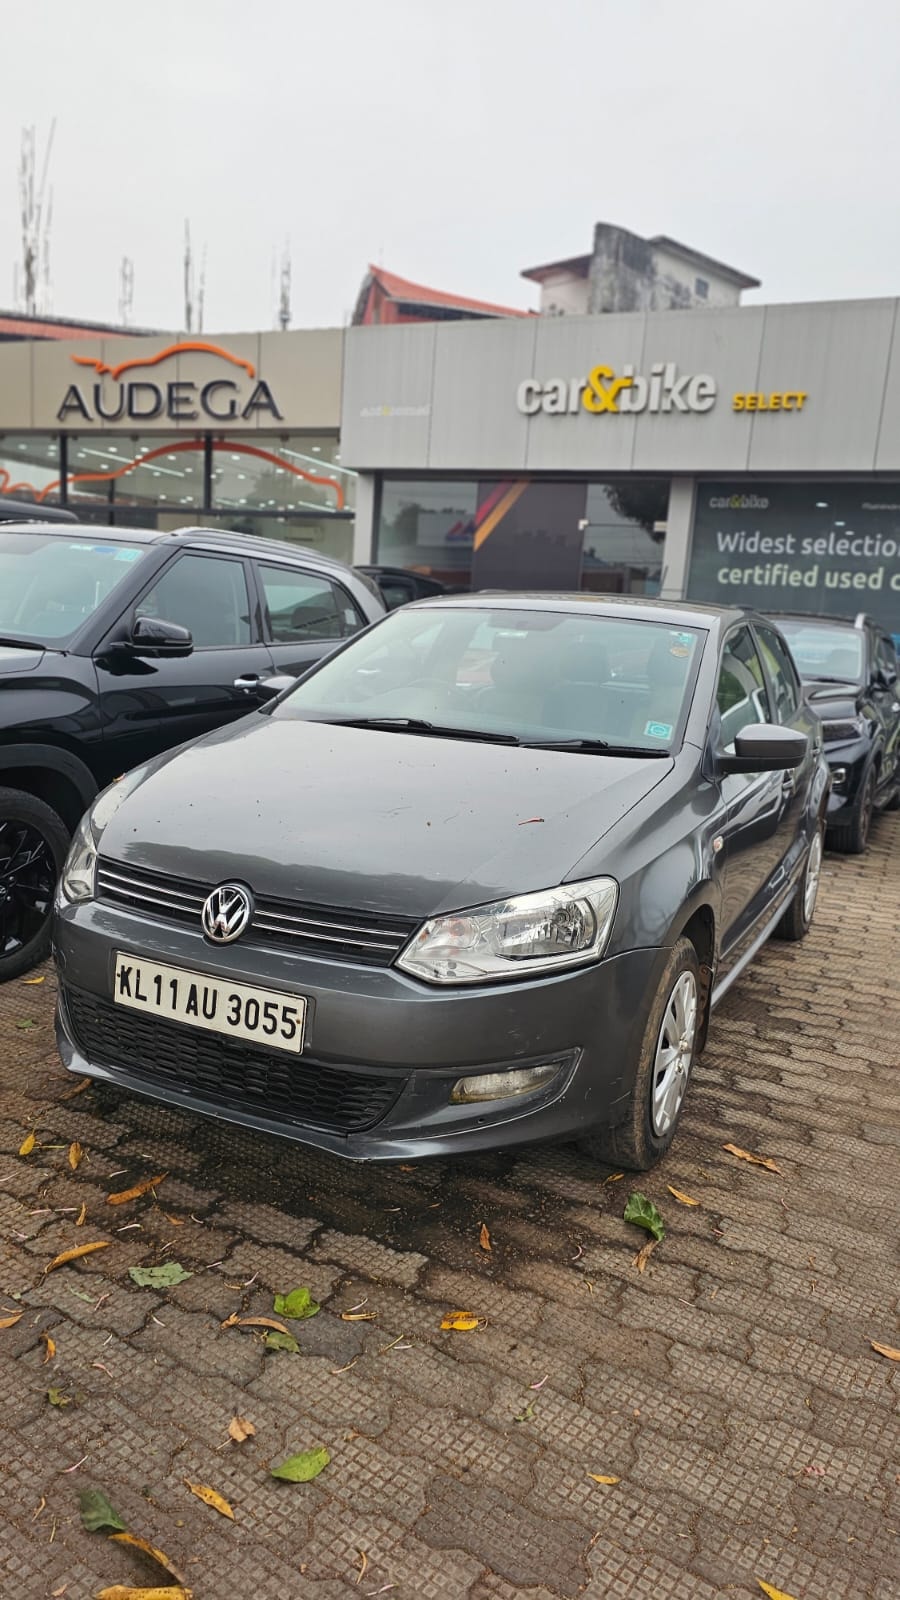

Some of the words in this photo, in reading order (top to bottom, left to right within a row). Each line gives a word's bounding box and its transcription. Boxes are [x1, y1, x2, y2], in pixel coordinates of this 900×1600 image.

[57, 380, 284, 422] AUDEGA
[516, 363, 717, 414] car&bike
[732, 392, 807, 411] SELECT
[717, 531, 795, 554] Widest
[801, 532, 900, 557] selectio
[717, 564, 819, 587] certified
[824, 567, 885, 590] used
[226, 994, 296, 1039] 3055
